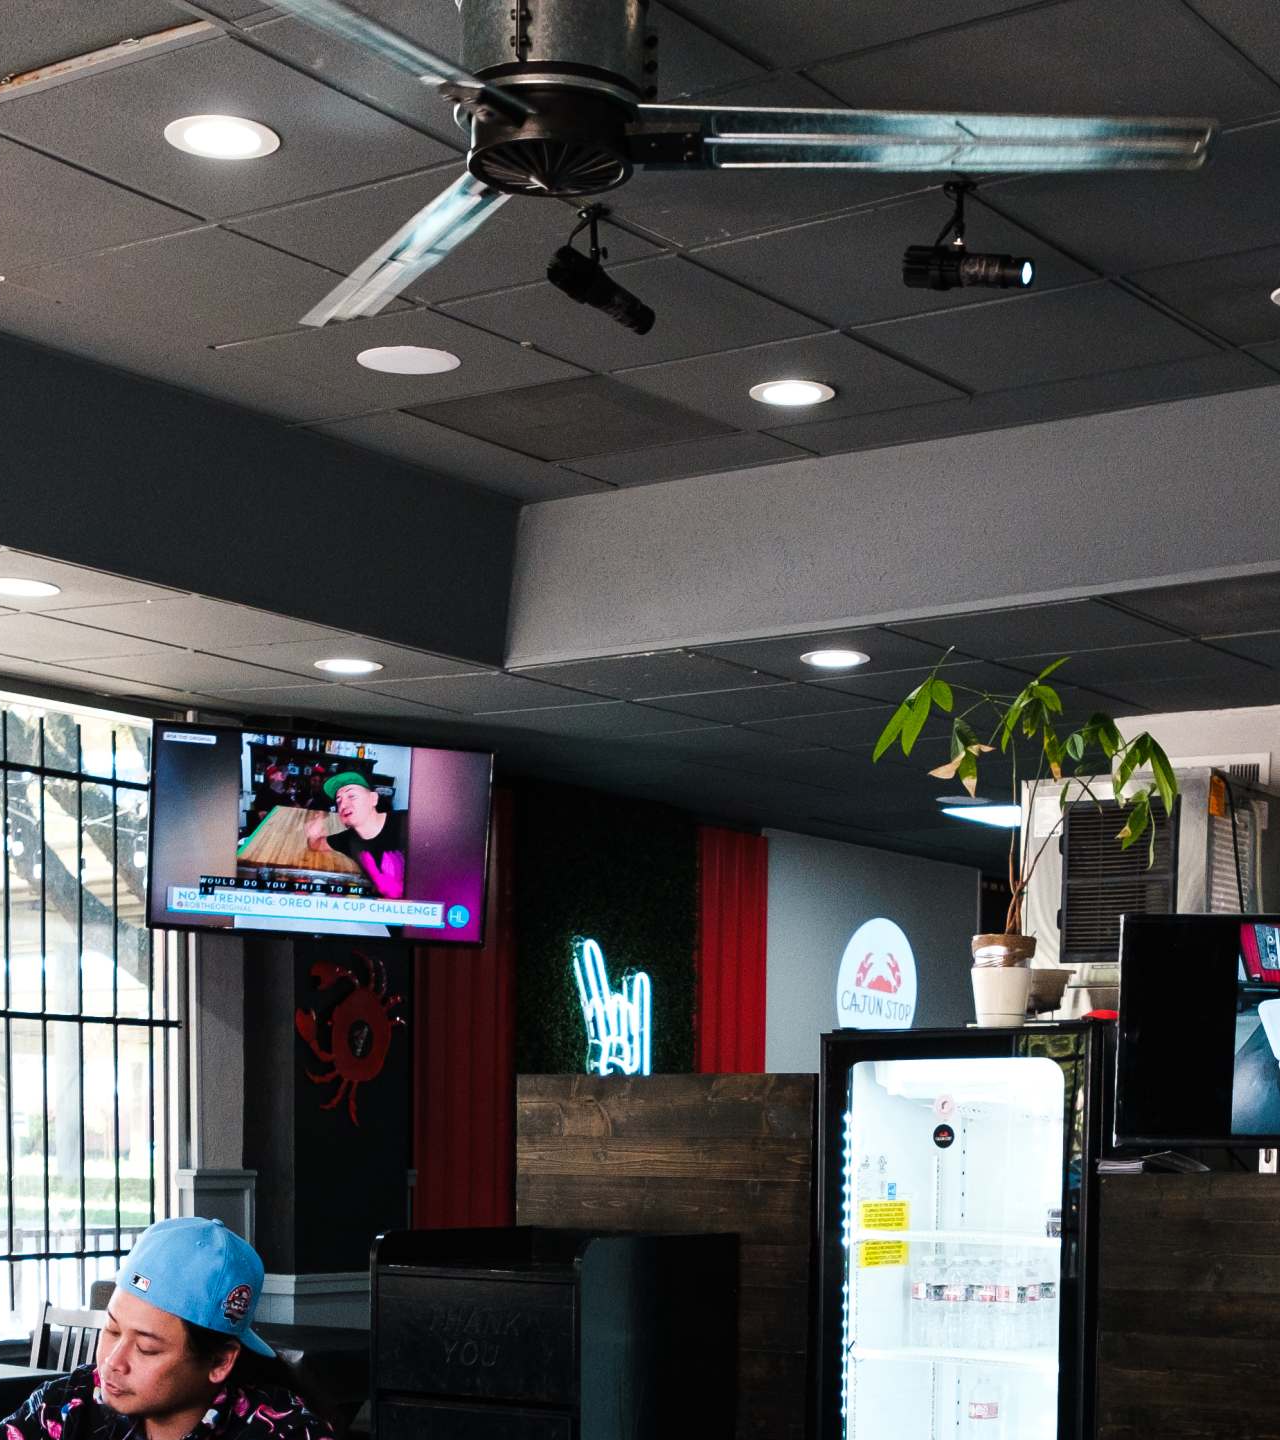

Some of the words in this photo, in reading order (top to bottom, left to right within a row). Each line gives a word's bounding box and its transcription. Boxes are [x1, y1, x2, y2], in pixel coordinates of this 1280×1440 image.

[200, 876, 236, 887] WOULD
[243, 879, 258, 888] DO
[266, 881, 287, 890] YOU
[294, 882, 322, 892] THIS
[329, 885, 344, 894] TO
[278, 896, 312, 909] OREO
[316, 898, 329, 909] IN
[332, 900, 340, 910] A
[343, 901, 366, 912] CUP
[369, 902, 438, 917] CHALLENGE
[841, 989, 883, 1017] CAJUN
[886, 998, 913, 1023] STOP
[444, 1340, 500, 1368] YOU
